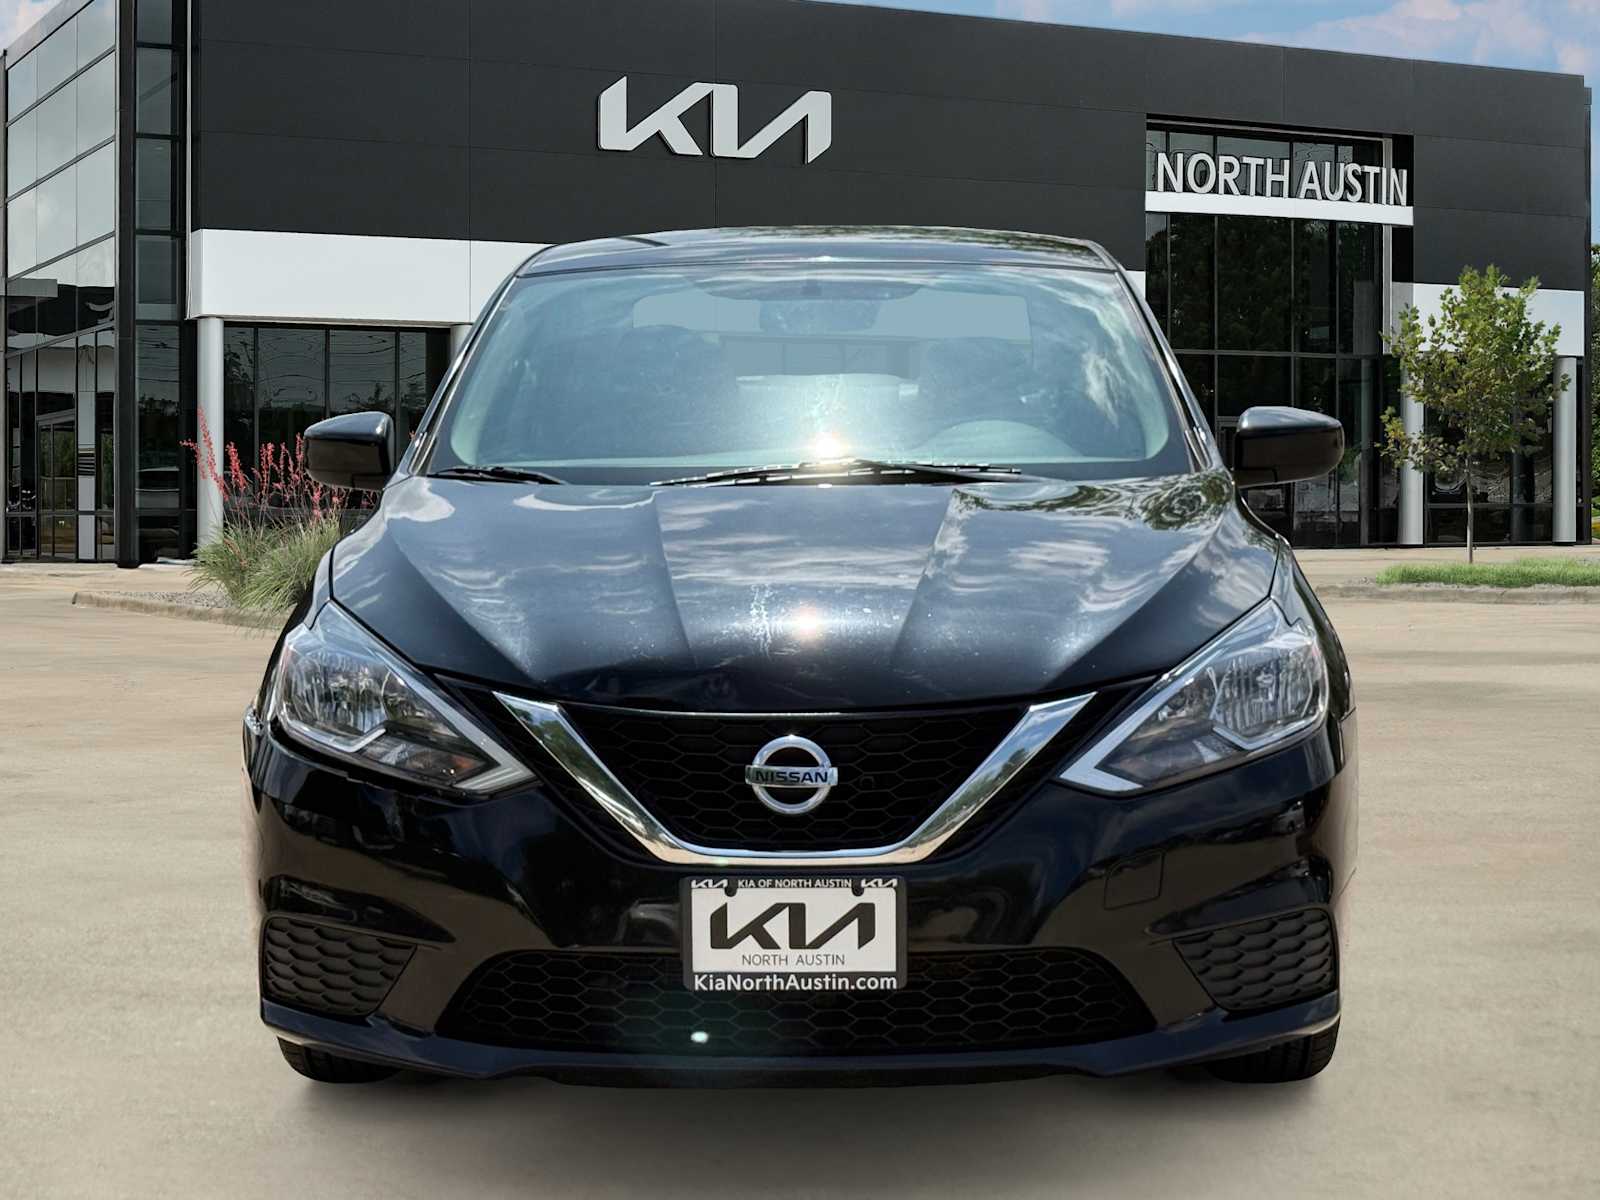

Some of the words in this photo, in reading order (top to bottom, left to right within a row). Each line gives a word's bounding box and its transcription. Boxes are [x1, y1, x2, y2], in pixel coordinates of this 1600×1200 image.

[598, 76, 832, 165] KIA
[1156, 152, 1290, 198] NORTH
[1299, 160, 1408, 206] AUSTIN
[755, 771, 828, 783] NISSAN
[738, 879, 756, 888] KIA
[758, 879, 773, 888] OF
[775, 879, 812, 888] NORTH
[815, 879, 852, 888] AUSTIN
[710, 902, 876, 950] KIA
[742, 954, 788, 966] NORTH
[795, 954, 845, 966] AUSTIN
[694, 974, 898, 991] KiaNorthAustin.com
